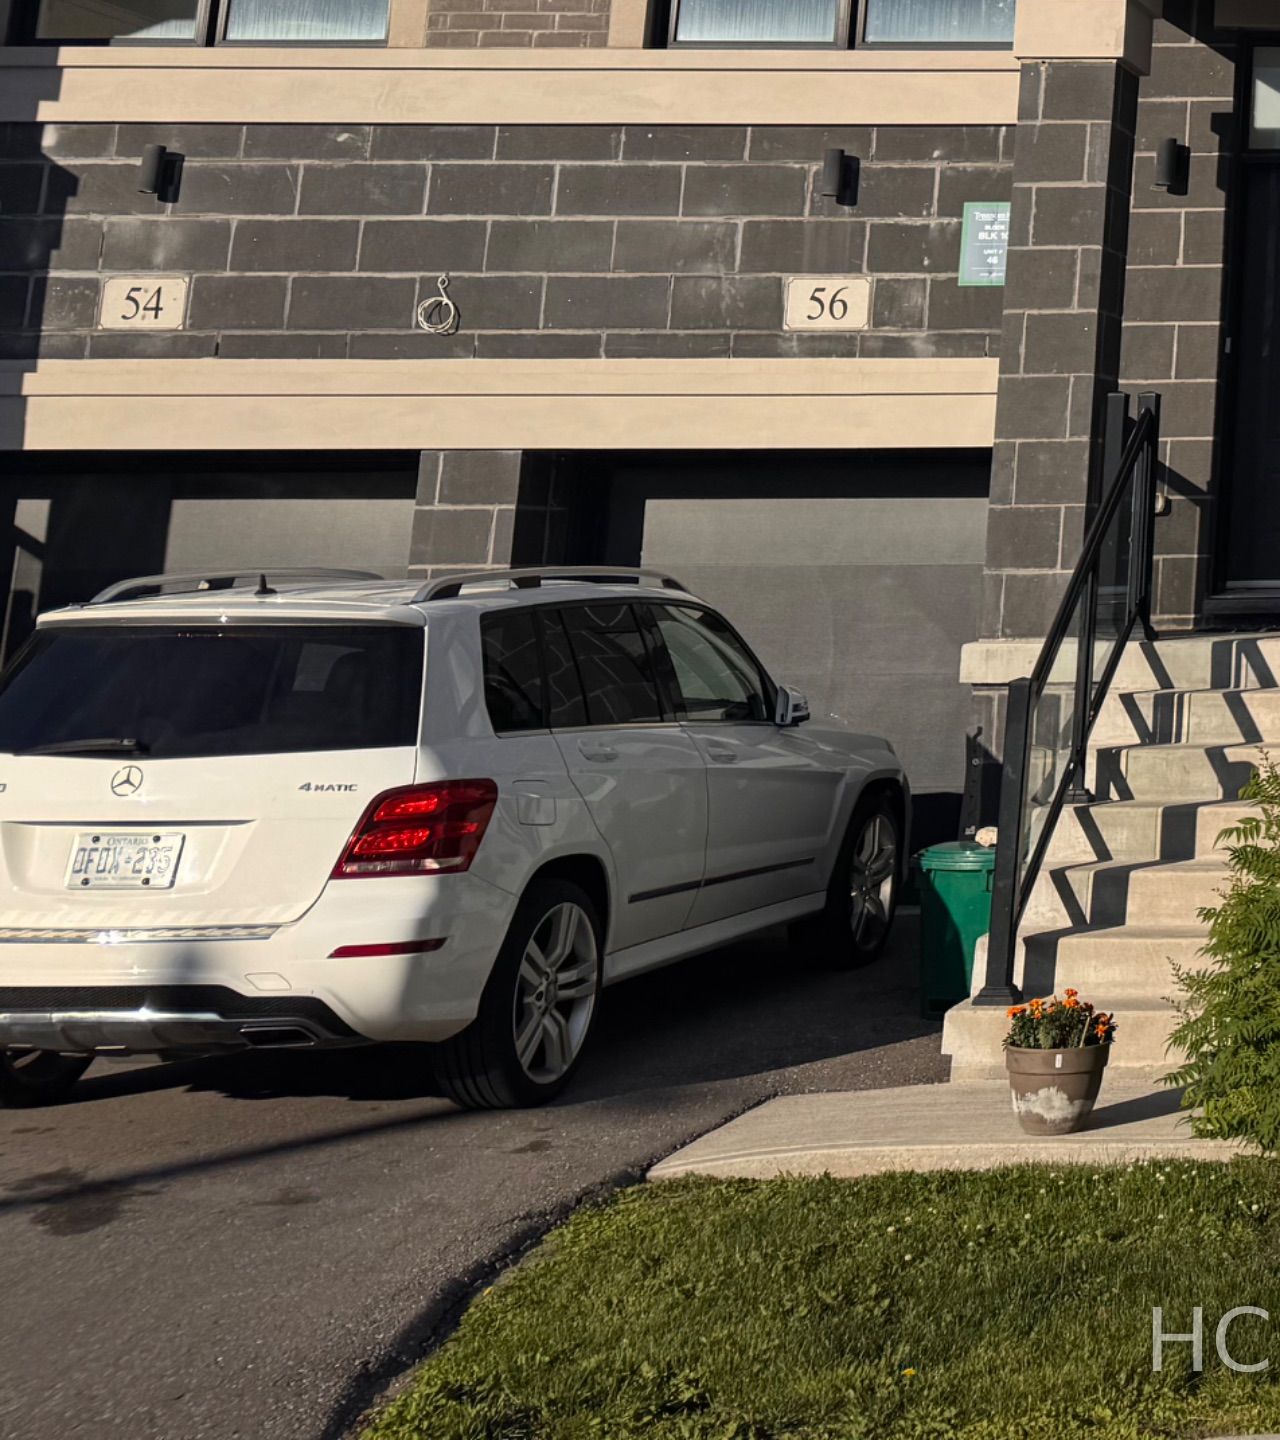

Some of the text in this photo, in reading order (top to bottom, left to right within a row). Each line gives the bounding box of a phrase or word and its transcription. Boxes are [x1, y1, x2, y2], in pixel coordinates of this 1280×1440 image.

[978, 231, 998, 240] BLK
[121, 286, 163, 320] 54
[806, 286, 849, 320] 56
